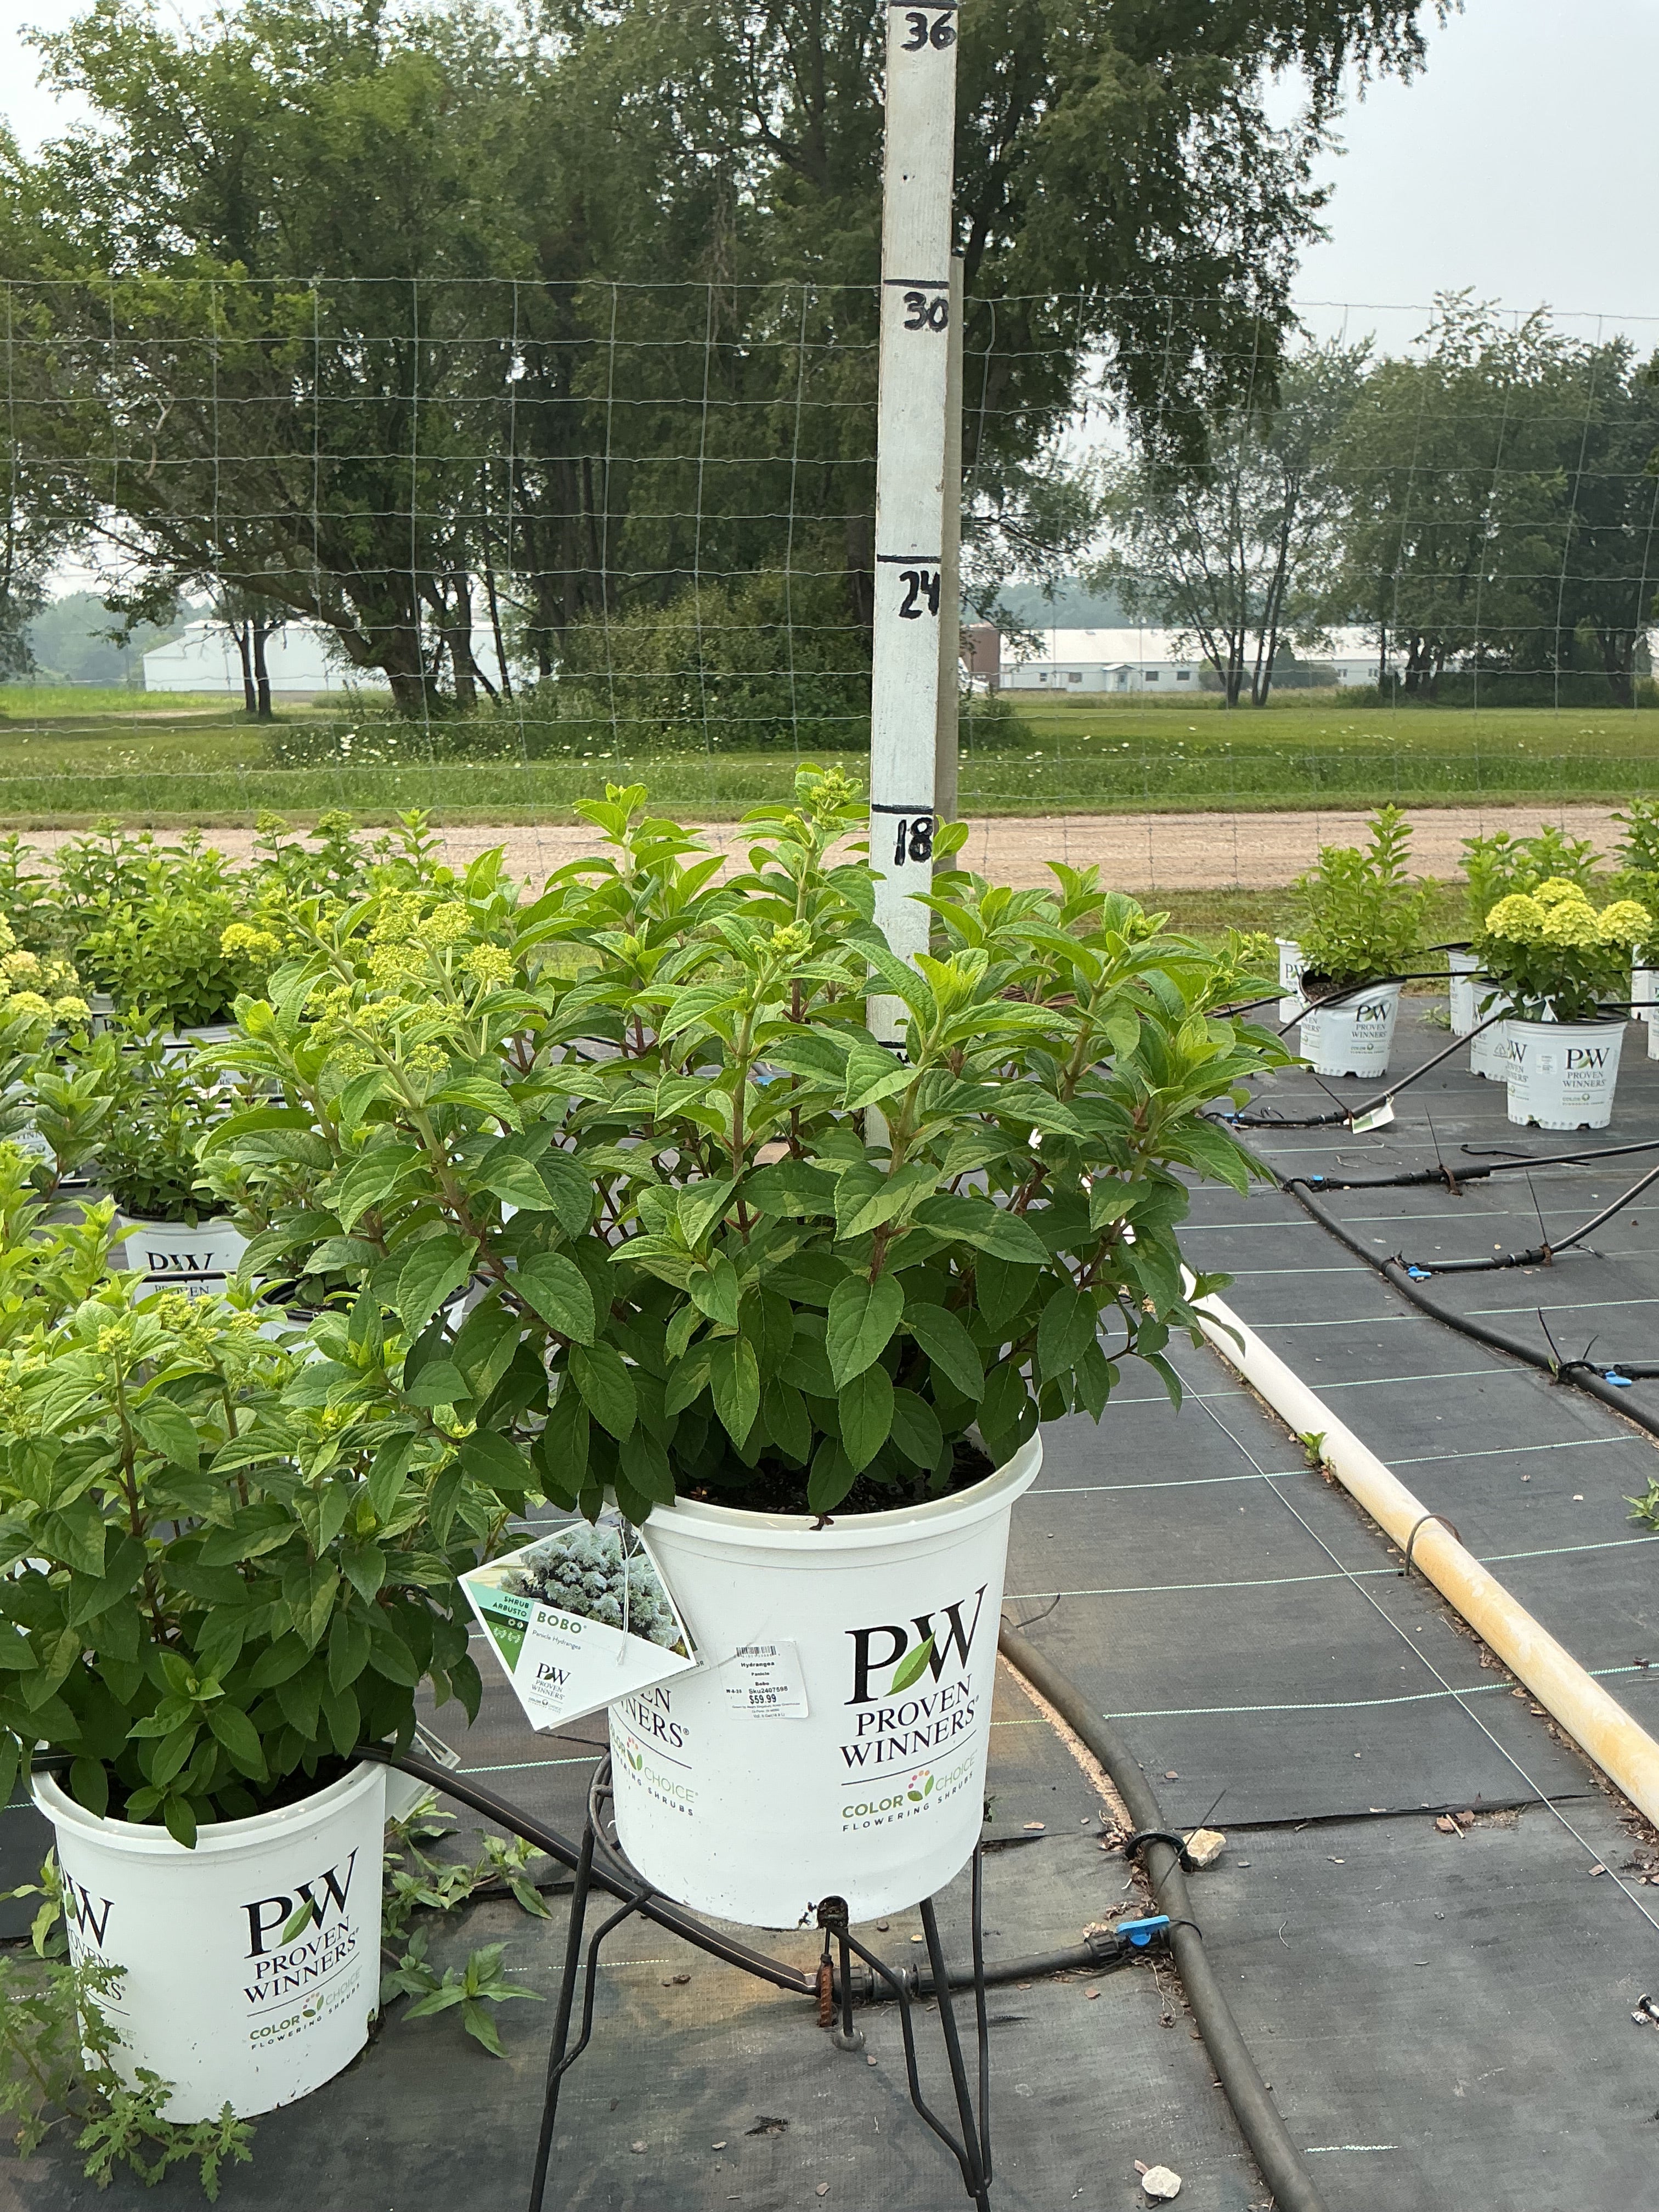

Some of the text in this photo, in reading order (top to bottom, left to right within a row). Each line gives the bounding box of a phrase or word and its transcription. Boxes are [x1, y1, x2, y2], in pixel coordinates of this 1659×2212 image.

[900, 11, 956, 52] 36
[903, 291, 949, 332] 30
[899, 569, 940, 619] 24
[894, 816, 934, 865] 18
[1356, 1001, 1392, 1022] PW
[1564, 1047, 1610, 1070] PW
[1567, 1070, 1603, 1079] PROVEN
[492, 1601, 527, 1617] ARBUSTO
[504, 1596, 530, 1609] SHRUB
[844, 1583, 988, 1705] PW
[535, 1662, 572, 1685] PW
[535, 1679, 563, 1693] PROVEN
[749, 1694, 777, 1705] $59.99
[856, 1674, 973, 1737] PROVEN
[647, 1787, 694, 1816] SHRUBS
[842, 1794, 904, 1819] COLOR
[843, 1771, 973, 1833] FLOWERING SHRUBS
[240, 1846, 359, 1959] PW
[254, 1915, 351, 1980] PROVEN
[249, 2015, 301, 2041] COLOR
[251, 1982, 362, 2051] FLOWERING SHRUBS
